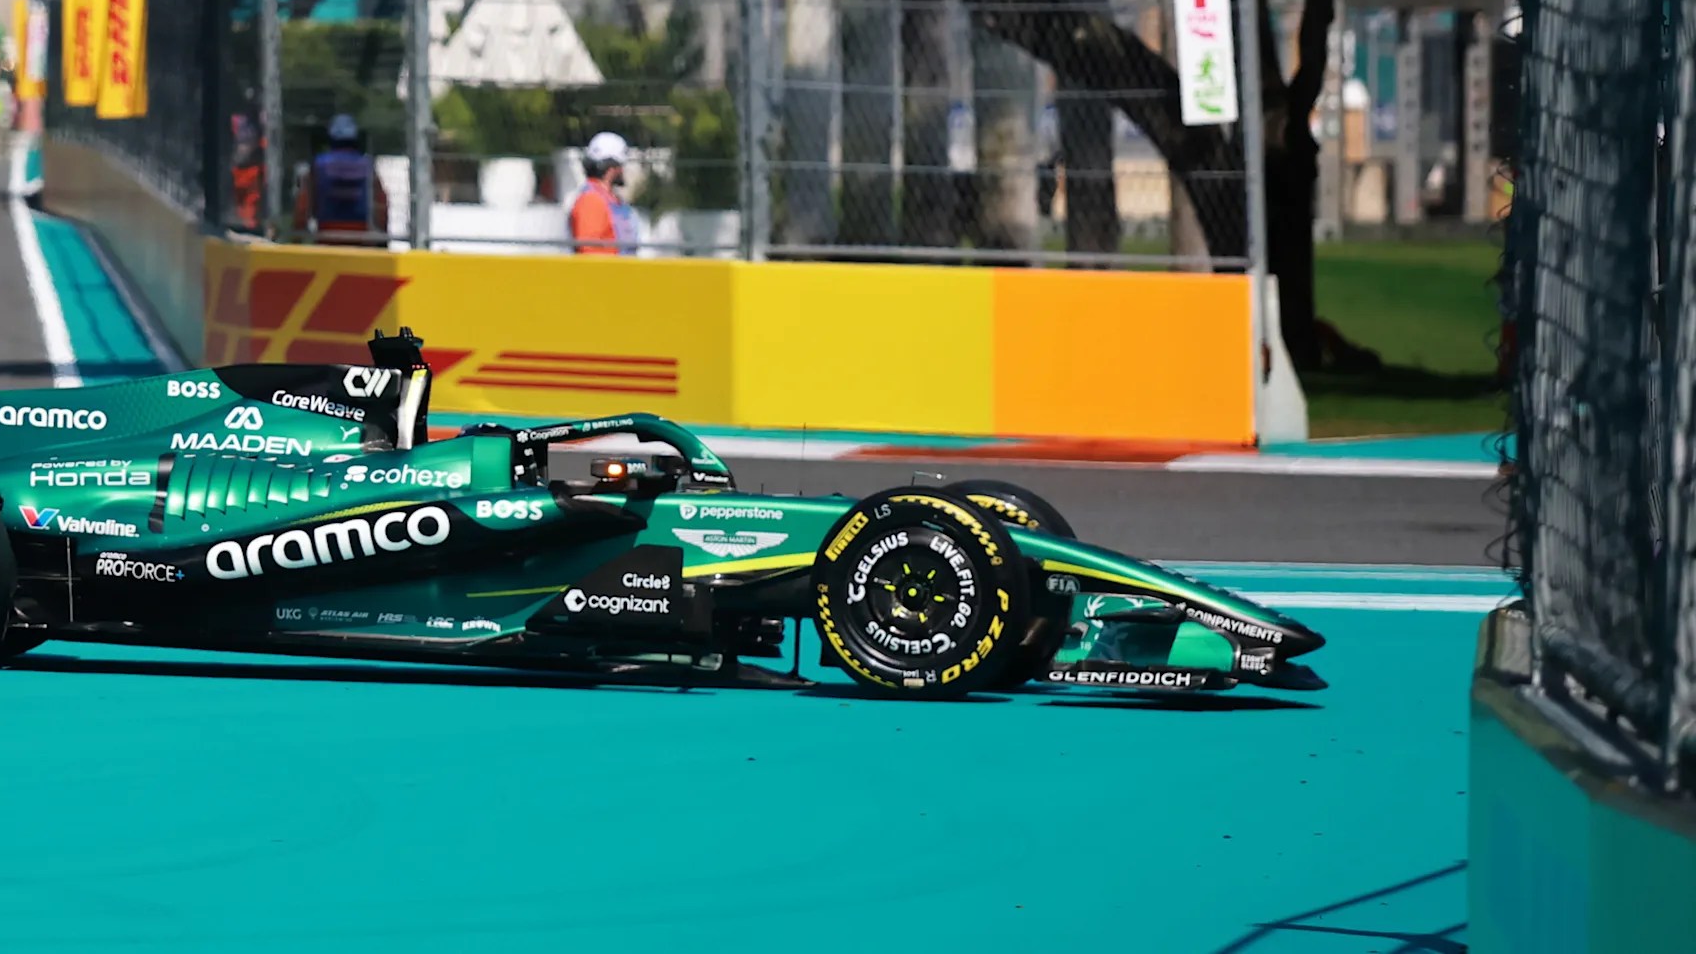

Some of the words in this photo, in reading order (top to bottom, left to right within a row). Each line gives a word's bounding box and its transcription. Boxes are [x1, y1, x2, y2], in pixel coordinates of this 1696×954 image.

[205, 266, 474, 380] HL
[166, 380, 221, 398] BOSS
[271, 390, 366, 422] CoreWeave
[592, 418, 634, 429] BREITLING
[530, 427, 569, 441] Cognition
[170, 433, 312, 456] MAADEN
[31, 459, 107, 469] Powered
[111, 459, 133, 469] by
[30, 469, 151, 487] Honda
[370, 466, 463, 489] cohere
[476, 500, 544, 521] BOSS
[700, 506, 784, 520] pepperstone
[57, 516, 137, 537] Valvoline
[824, 510, 869, 562] PIRELLI
[206, 506, 450, 580] aramco
[729, 536, 755, 544] MARTIN
[1048, 578, 1078, 592] FIA
[588, 594, 670, 616] cognizant
[997, 588, 1009, 612] P
[276, 608, 302, 620] UKG
[320, 609, 350, 617] ATLAS
[941, 615, 1004, 684] ZERO
[1049, 670, 1192, 686] GLENFIDDICH
